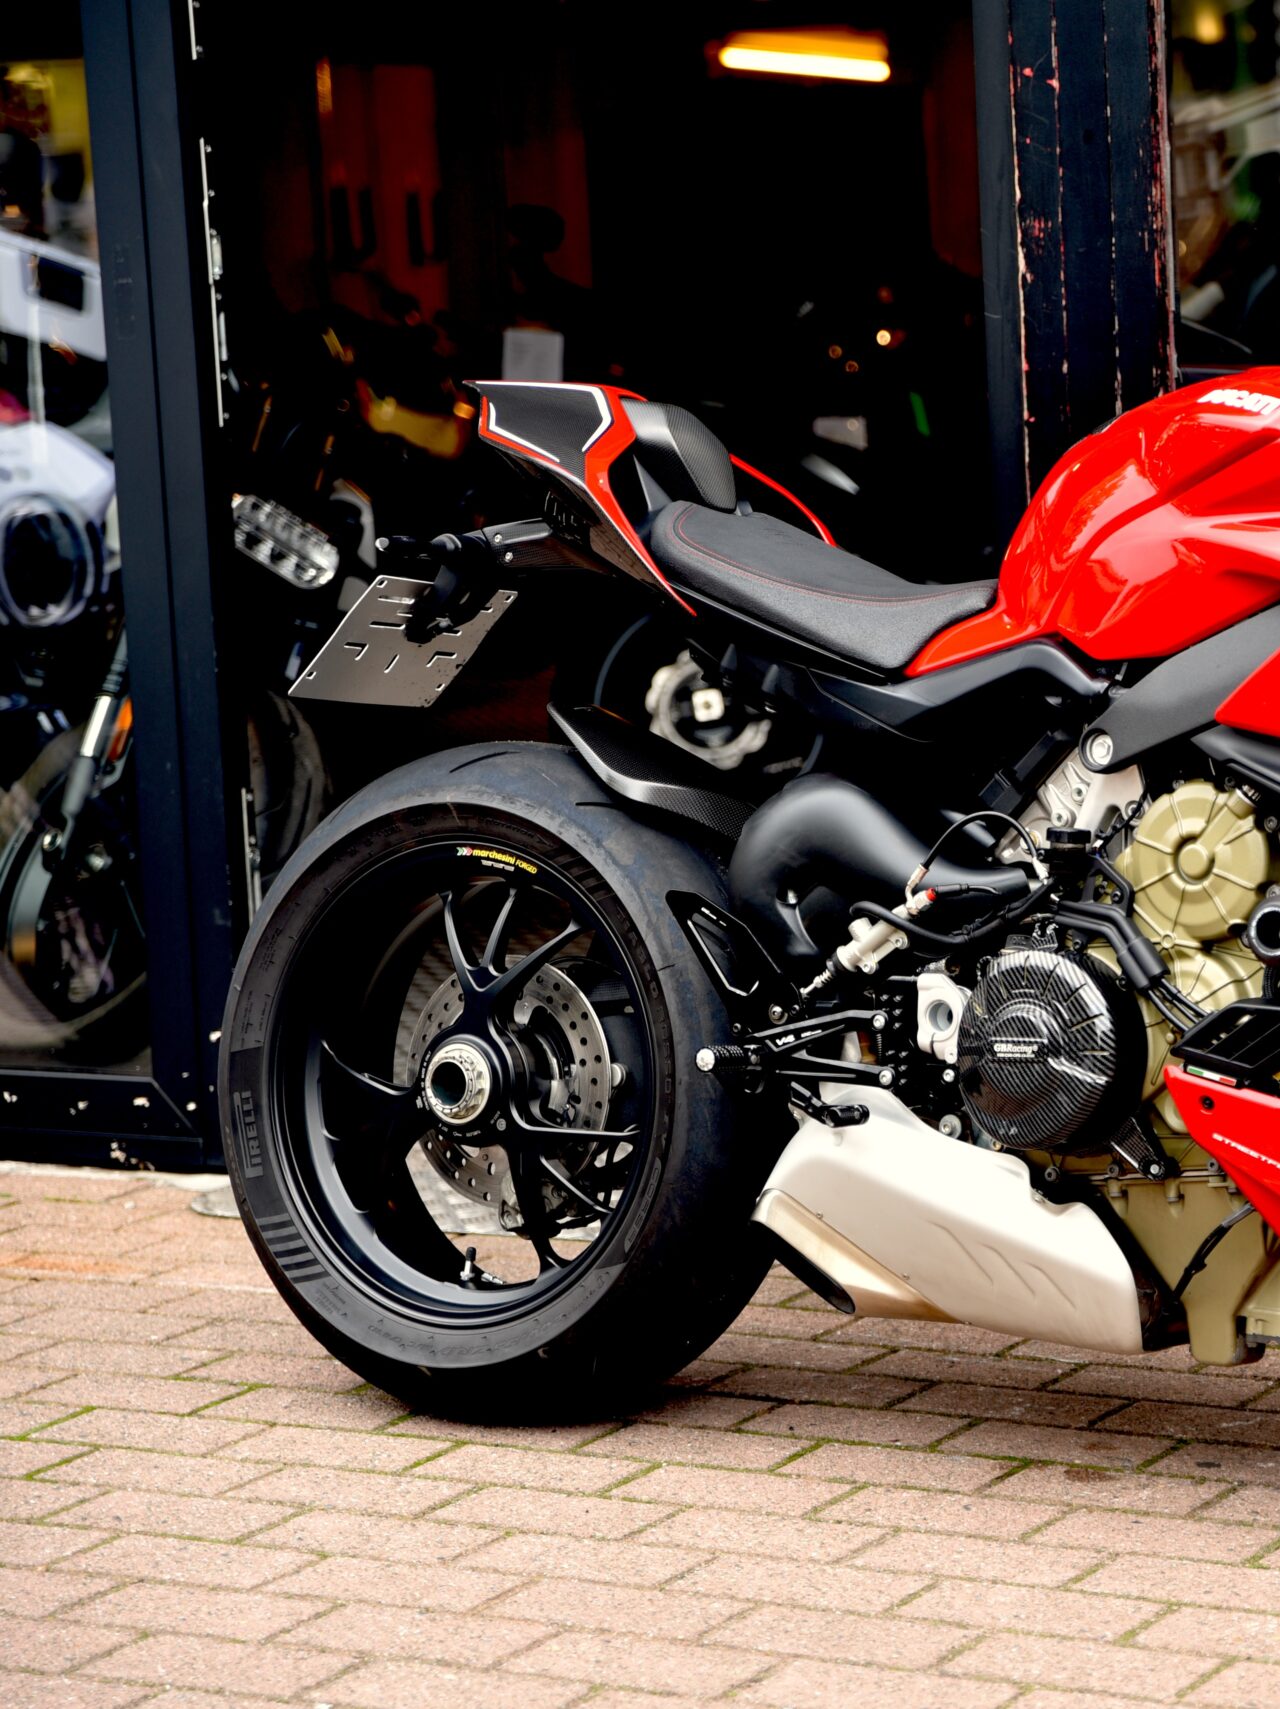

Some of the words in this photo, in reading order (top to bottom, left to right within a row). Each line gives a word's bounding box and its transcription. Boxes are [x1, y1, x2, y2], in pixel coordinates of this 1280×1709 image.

[472, 848, 516, 865] marchesini
[515, 858, 538, 874] FORGED
[233, 1090, 264, 1179] PIRELLI
